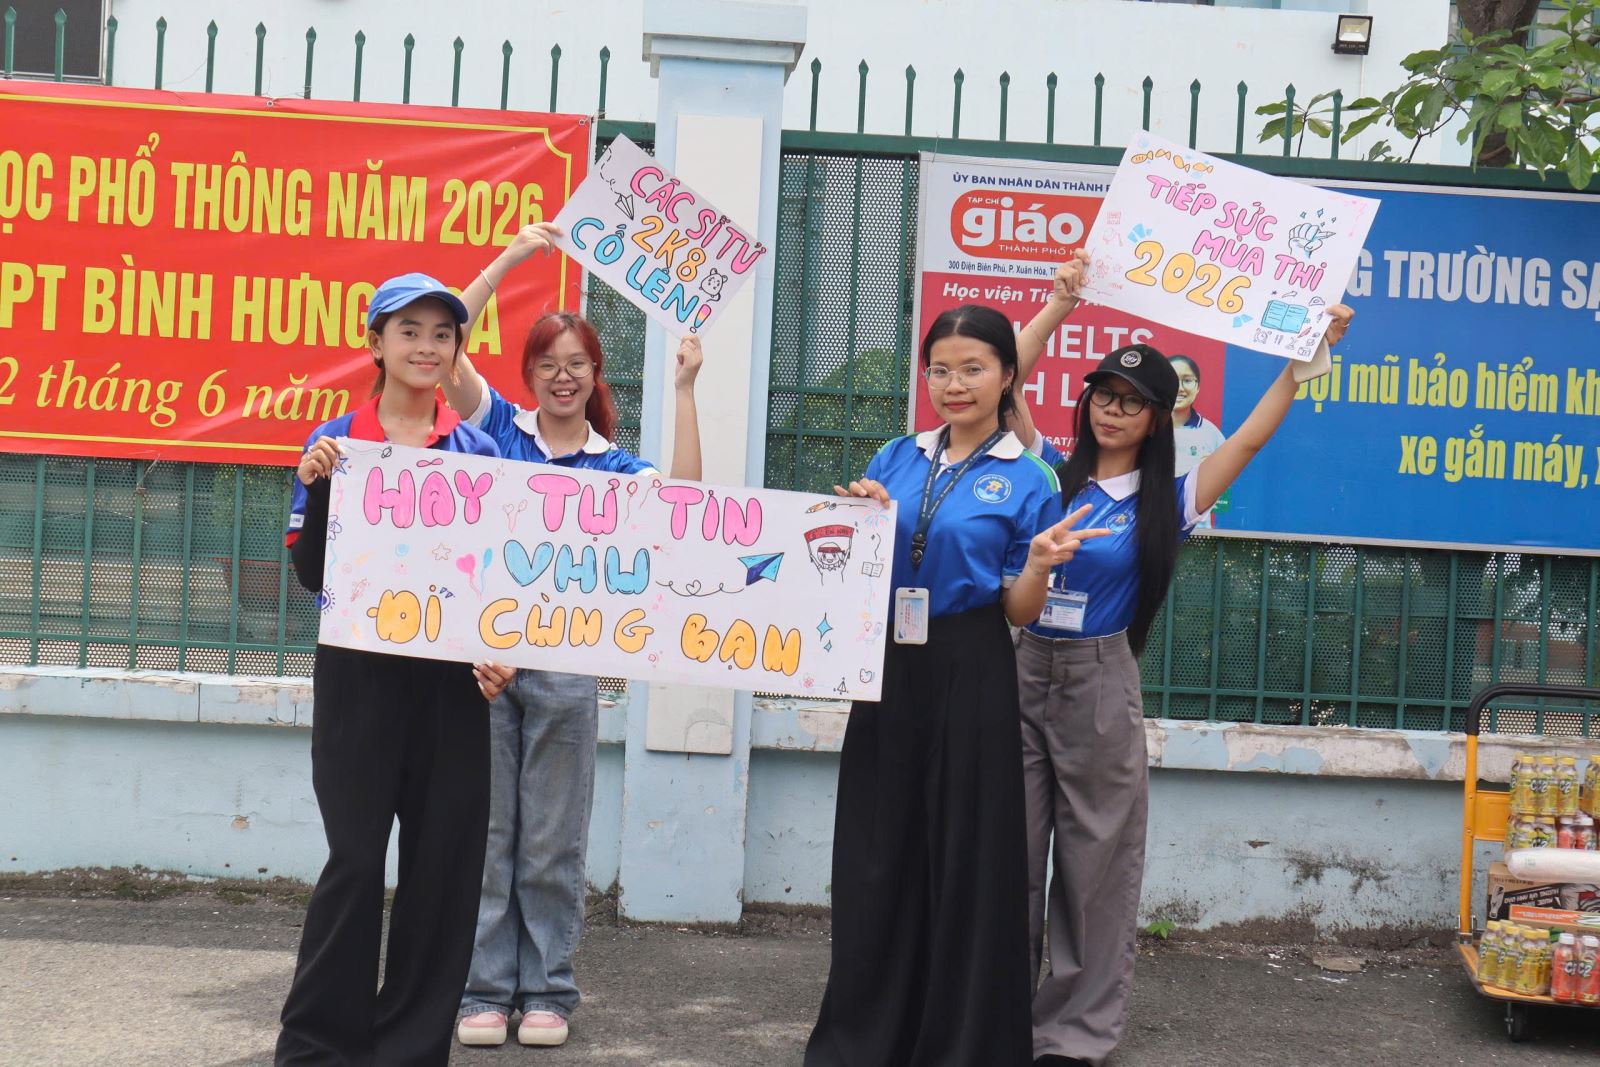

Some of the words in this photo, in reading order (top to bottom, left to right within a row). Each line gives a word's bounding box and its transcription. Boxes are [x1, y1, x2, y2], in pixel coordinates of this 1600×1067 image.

[67, 132, 161, 228] PHỔ
[170, 150, 312, 237] THÔNG
[326, 159, 427, 243] NĂM
[440, 178, 543, 246] 2026
[630, 166, 696, 223] CÁC
[953, 172, 969, 184] ỦY
[972, 175, 995, 185] BAN
[998, 176, 1032, 188] NHÂN
[1035, 179, 1060, 190] DÂN
[1063, 181, 1103, 192] THÀNH
[571, 216, 627, 265] CỐ
[631, 215, 706, 282] 2K8
[961, 196, 1084, 247] giáo
[999, 244, 1038, 254] THÀNH
[1042, 246, 1067, 256] PHỐ
[1214, 201, 1278, 242] SỨC
[82, 254, 213, 340] BÌNH
[942, 282, 980, 301] Học
[984, 285, 1024, 304] viện
[948, 260, 960, 270] 300
[961, 261, 976, 273] Điện
[977, 262, 991, 272] Biên
[1125, 239, 1252, 314] 2026
[1384, 244, 1552, 307] TRƯỜNG
[36, 359, 184, 427] tháng
[198, 369, 228, 417] 6
[243, 373, 350, 422] năm
[1348, 355, 1400, 405] mũ
[1407, 352, 1469, 409] bảo
[1475, 356, 1559, 413] hiểm
[1398, 435, 1437, 475] xe
[1443, 423, 1507, 483] gắn
[1513, 433, 1588, 490] máy,
[363, 458, 493, 529] HÃY
[478, 592, 655, 654] CÙNG
[680, 612, 802, 677] BẠN
